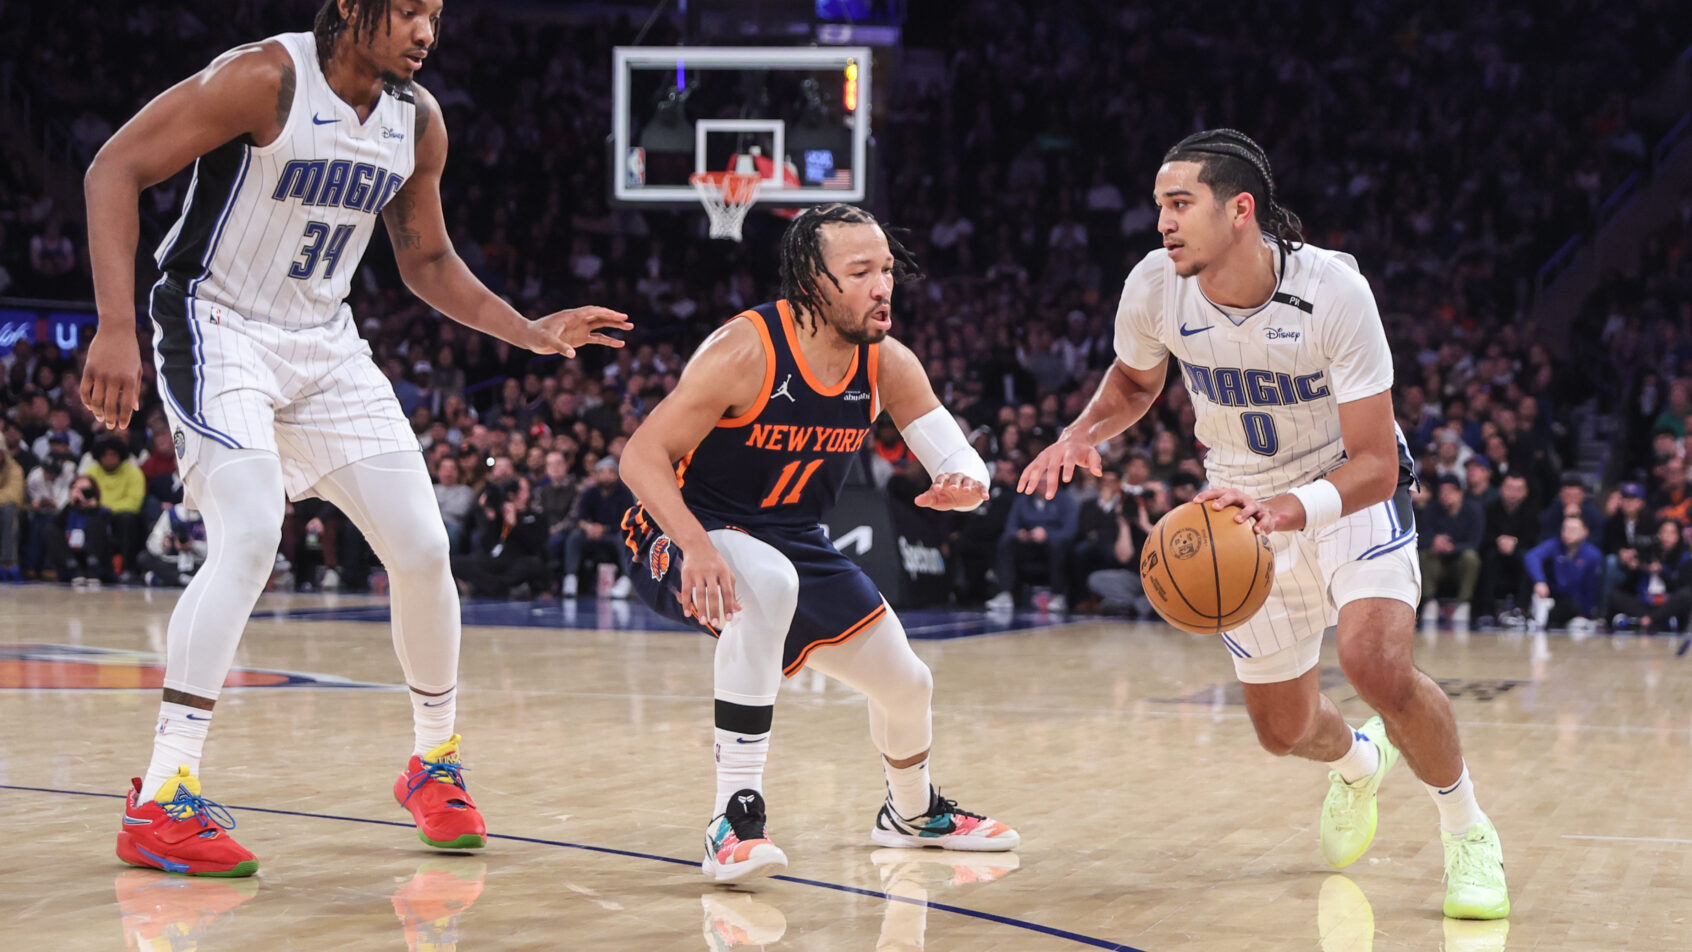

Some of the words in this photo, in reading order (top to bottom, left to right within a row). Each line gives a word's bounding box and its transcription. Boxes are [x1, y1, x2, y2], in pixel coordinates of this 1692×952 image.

[380, 126, 404, 142] Disney
[272, 159, 404, 214] MAGIC
[288, 220, 356, 280] 34
[1263, 327, 1301, 342] Disney
[1179, 360, 1330, 407] MAGIC
[745, 424, 812, 452] NEW
[812, 426, 870, 453] YORK
[1240, 412, 1279, 457] 0
[760, 458, 825, 508] 11
